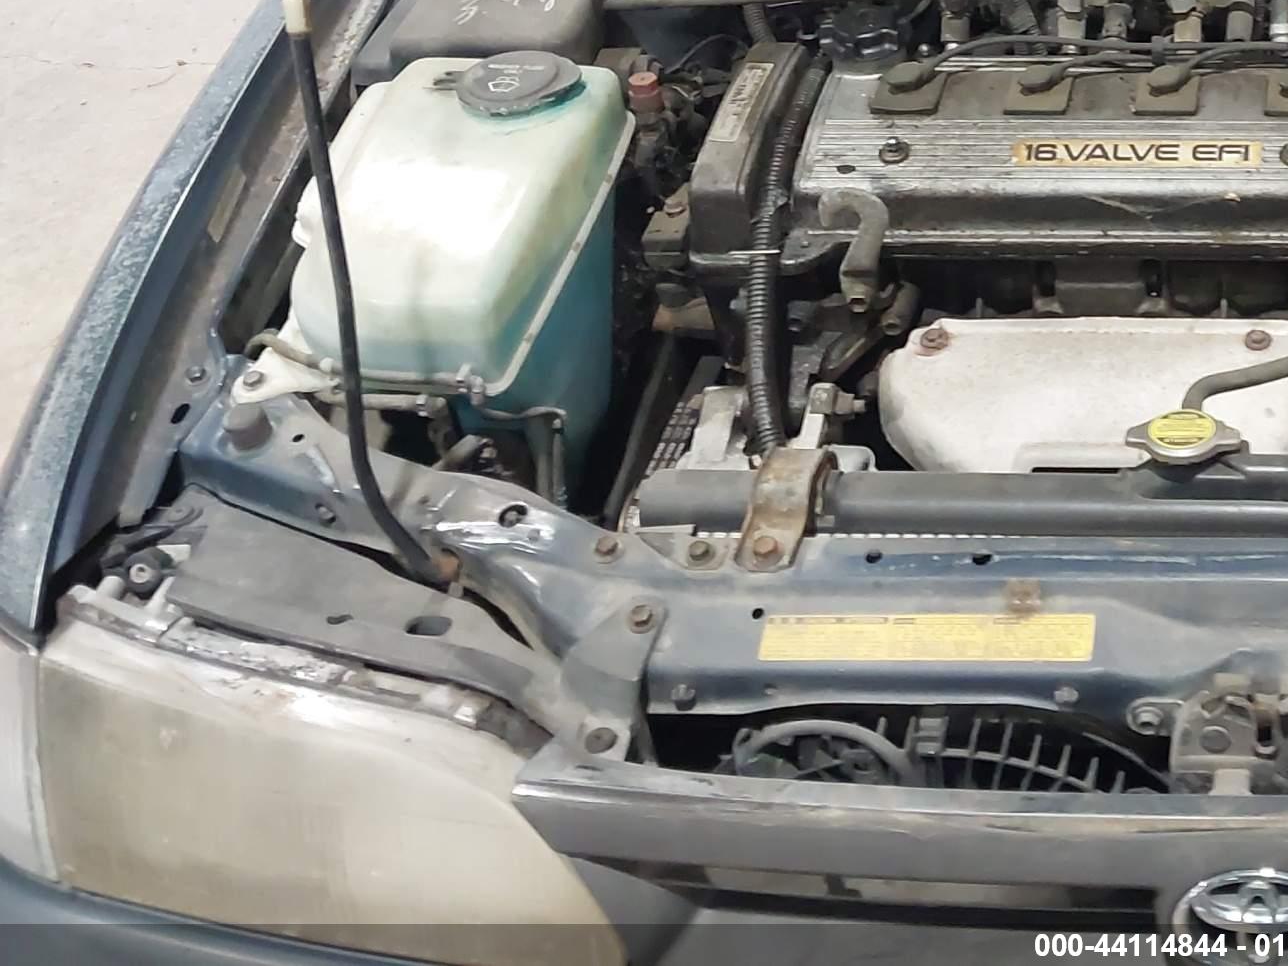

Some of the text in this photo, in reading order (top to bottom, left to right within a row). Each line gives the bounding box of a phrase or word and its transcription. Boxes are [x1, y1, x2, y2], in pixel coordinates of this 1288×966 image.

[1024, 142, 1250, 162] 16 VALVE EFI
